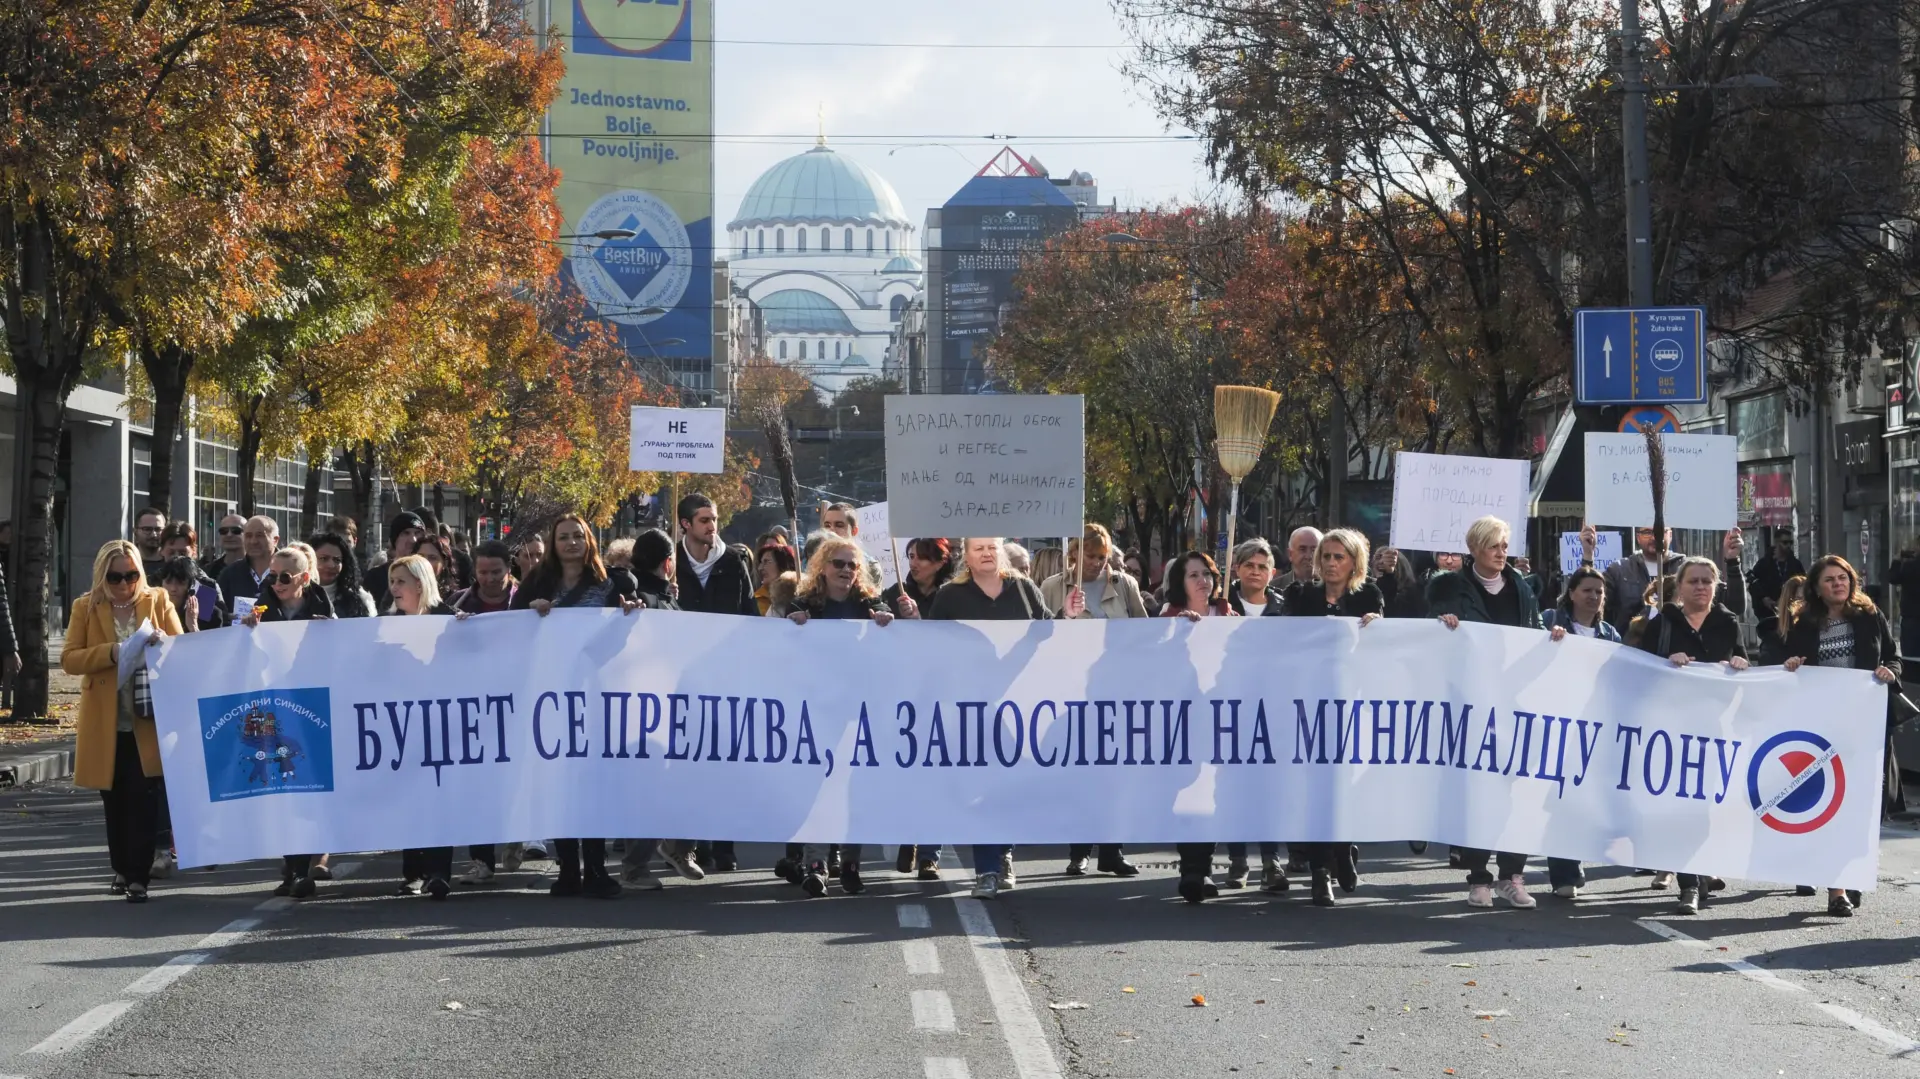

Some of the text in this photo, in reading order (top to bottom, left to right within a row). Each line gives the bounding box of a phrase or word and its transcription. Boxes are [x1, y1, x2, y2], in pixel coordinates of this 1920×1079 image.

[570, 88, 691, 112] Jednostavno.
[606, 115, 657, 137] Bolje.
[583, 139, 679, 164] Povoljnije.
[622, 195, 641, 203] LIDL
[604, 247, 663, 270] BestBuy
[620, 267, 646, 275] AWARD
[1648, 314, 1667, 322] Жута
[1658, 377, 1675, 387] BUS
[668, 421, 688, 434] НЕ
[1023, 414, 1061, 427] ОБРОК
[939, 444, 948, 455] И
[958, 443, 1008, 456] РЕГРЕС
[901, 470, 1076, 489] МАЊЕ ОД МИНИМАЛНЕ
[1422, 487, 1506, 509] ПОРОДИЦЕ
[1412, 529, 1468, 548] ДЕЦ
[205, 697, 328, 740] САМОСТАЛНИ СИНДИКАТ
[353, 691, 1742, 804] БУЏЕТ СЕ ПРЕЛИВА, А ЗАПОСЛЕНИ НА МИНИМАЛЦУ ТОНУ
[1756, 747, 1837, 817] СИНДИКАТ УПРАВЕ СРБИЈЕ
